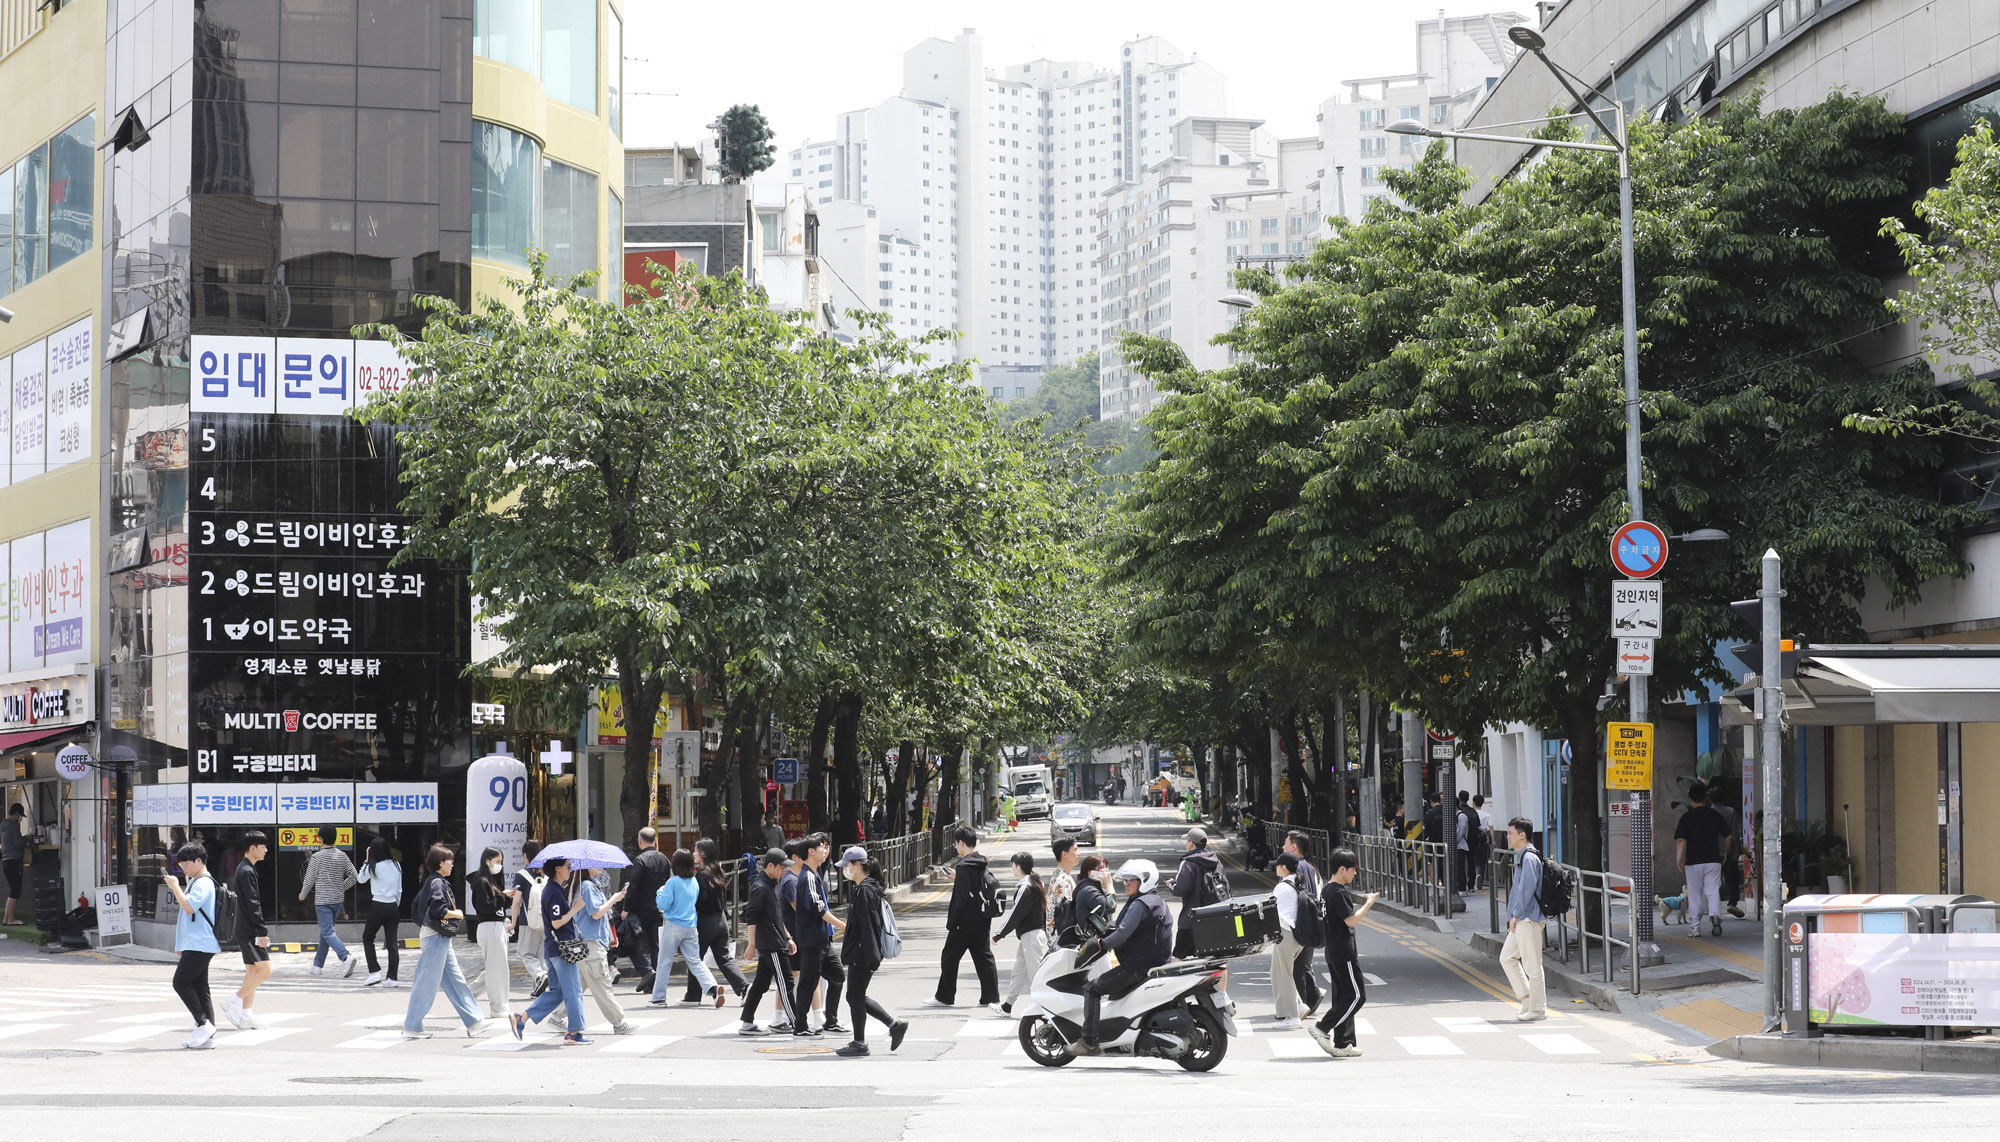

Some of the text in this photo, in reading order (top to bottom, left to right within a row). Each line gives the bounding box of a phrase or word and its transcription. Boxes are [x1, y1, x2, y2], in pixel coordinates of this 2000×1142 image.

[51, 330, 90, 375] 코수술전문
[200, 351, 347, 400] 임대 문의
[359, 366, 434, 390] 02-822-
[51, 388, 64, 416] 비염
[15, 413, 44, 455] 당일발급
[59, 421, 80, 453] 코성형
[201, 428, 216, 452] 5
[200, 476, 217, 501] 4
[201, 521, 215, 545] 3
[200, 570, 426, 598] 2 드림이비인후과
[1616, 590, 1659, 603] 견인지역
[46, 629, 60, 649] Dream
[61, 626, 69, 647] We
[70, 624, 81, 645] Care
[202, 617, 352, 645] 1 이도약국
[244, 658, 381, 676] 영계소문 옛날통닭
[32, 688, 70, 719] COFFEE
[472, 703, 505, 725] 도약국
[224, 713, 378, 730] MULTI COFFEE
[61, 754, 88, 764] COFFEE
[197, 750, 316, 773] B1 구공빈티지
[777, 762, 793, 774] 24
[195, 795, 273, 812] 구공빈티지
[281, 795, 350, 811] 구공빈티지
[359, 794, 435, 811] 구공빈티지
[489, 776, 526, 812] 90
[299, 834, 350, 845] 주차지
[104, 892, 120, 906] 90
[552, 904, 561, 916] 3
